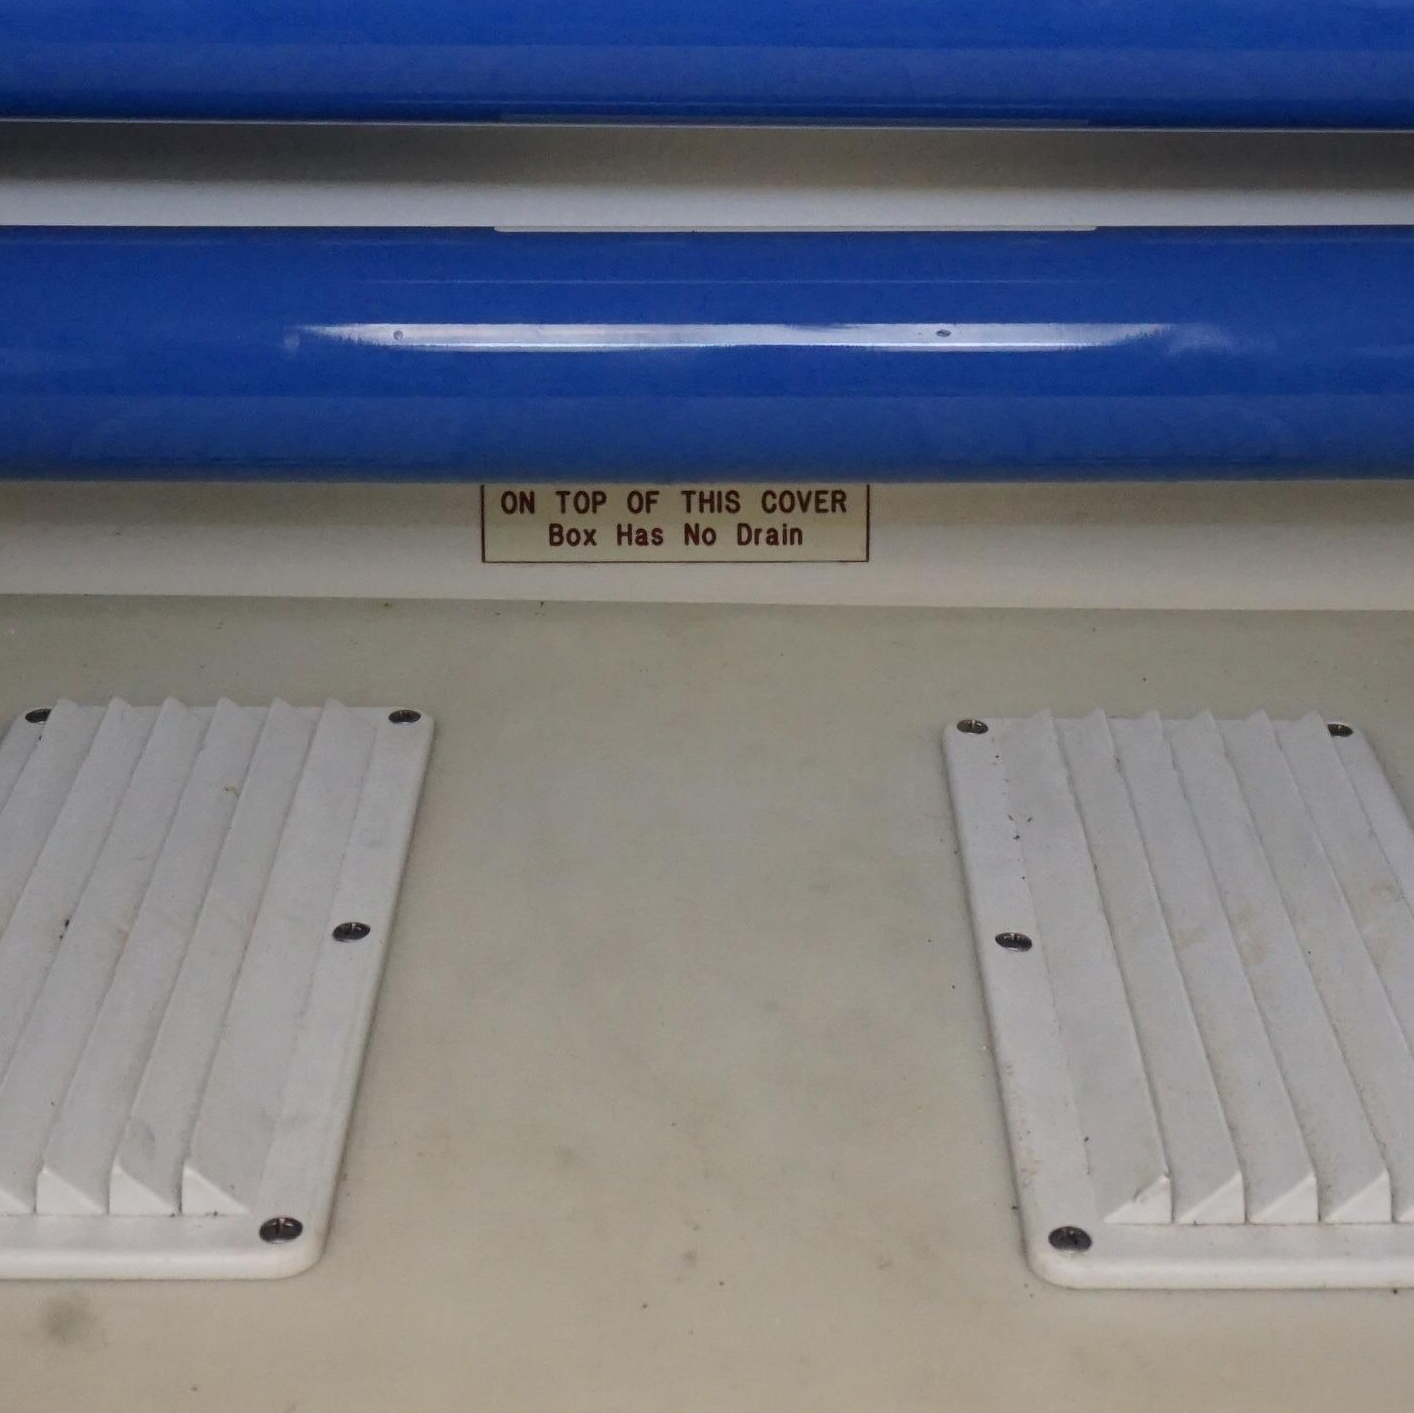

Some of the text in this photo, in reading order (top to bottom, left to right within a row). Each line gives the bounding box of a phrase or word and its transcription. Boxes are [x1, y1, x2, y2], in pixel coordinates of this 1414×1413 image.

[500, 489, 847, 515] ON TOP OF THIS COVER
[548, 522, 803, 547] Box Has No Drain
